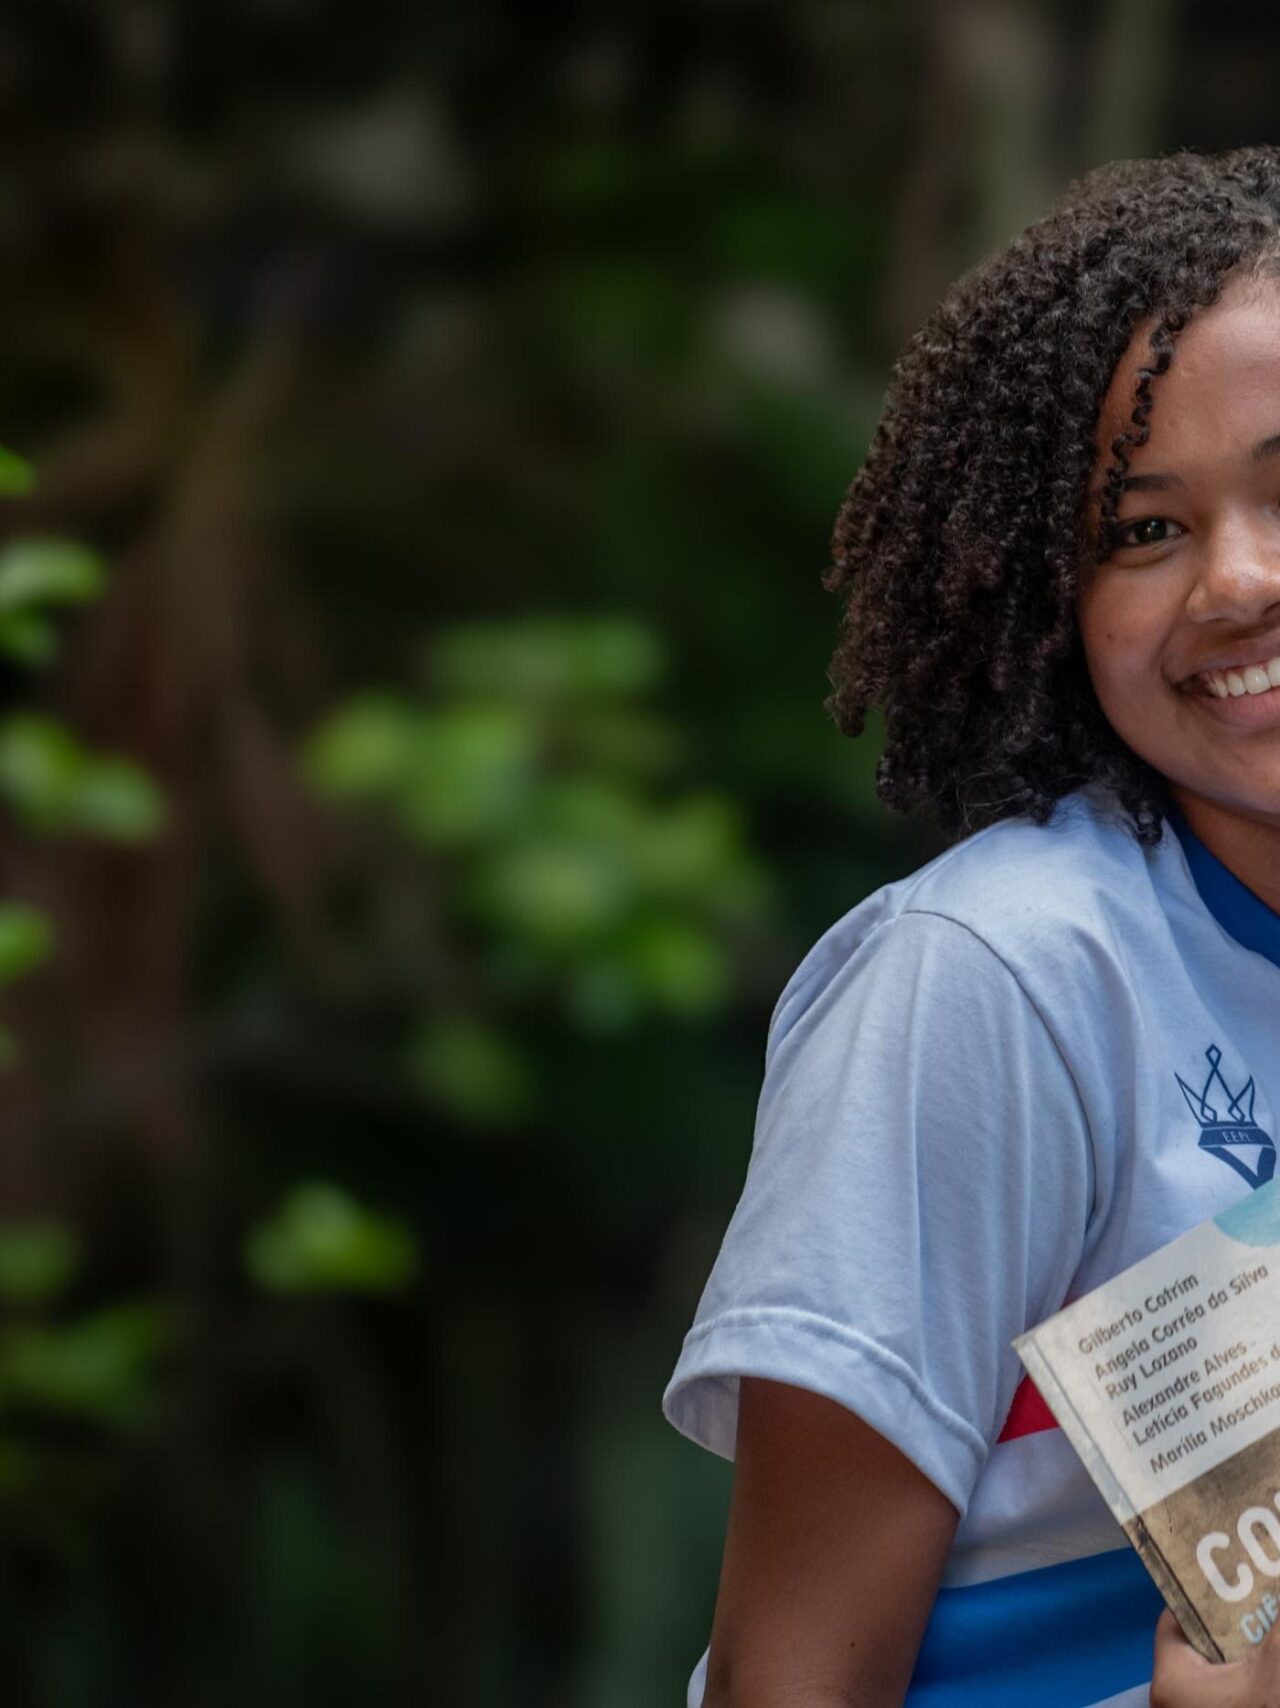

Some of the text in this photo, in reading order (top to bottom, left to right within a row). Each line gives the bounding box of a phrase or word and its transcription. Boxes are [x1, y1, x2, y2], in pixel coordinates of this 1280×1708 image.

[1078, 1274, 1199, 1354] Gilberto Cotrim
[1095, 1264, 1269, 1381] Angela Corrêa da Silva
[1105, 1336, 1198, 1400] Ruy Lozano
[1122, 1341, 1247, 1427] Alexandre Alves
[1132, 1407, 1189, 1447] Letícia
[1190, 1355, 1268, 1410] Fagundes
[1149, 1430, 1208, 1474] Marília
